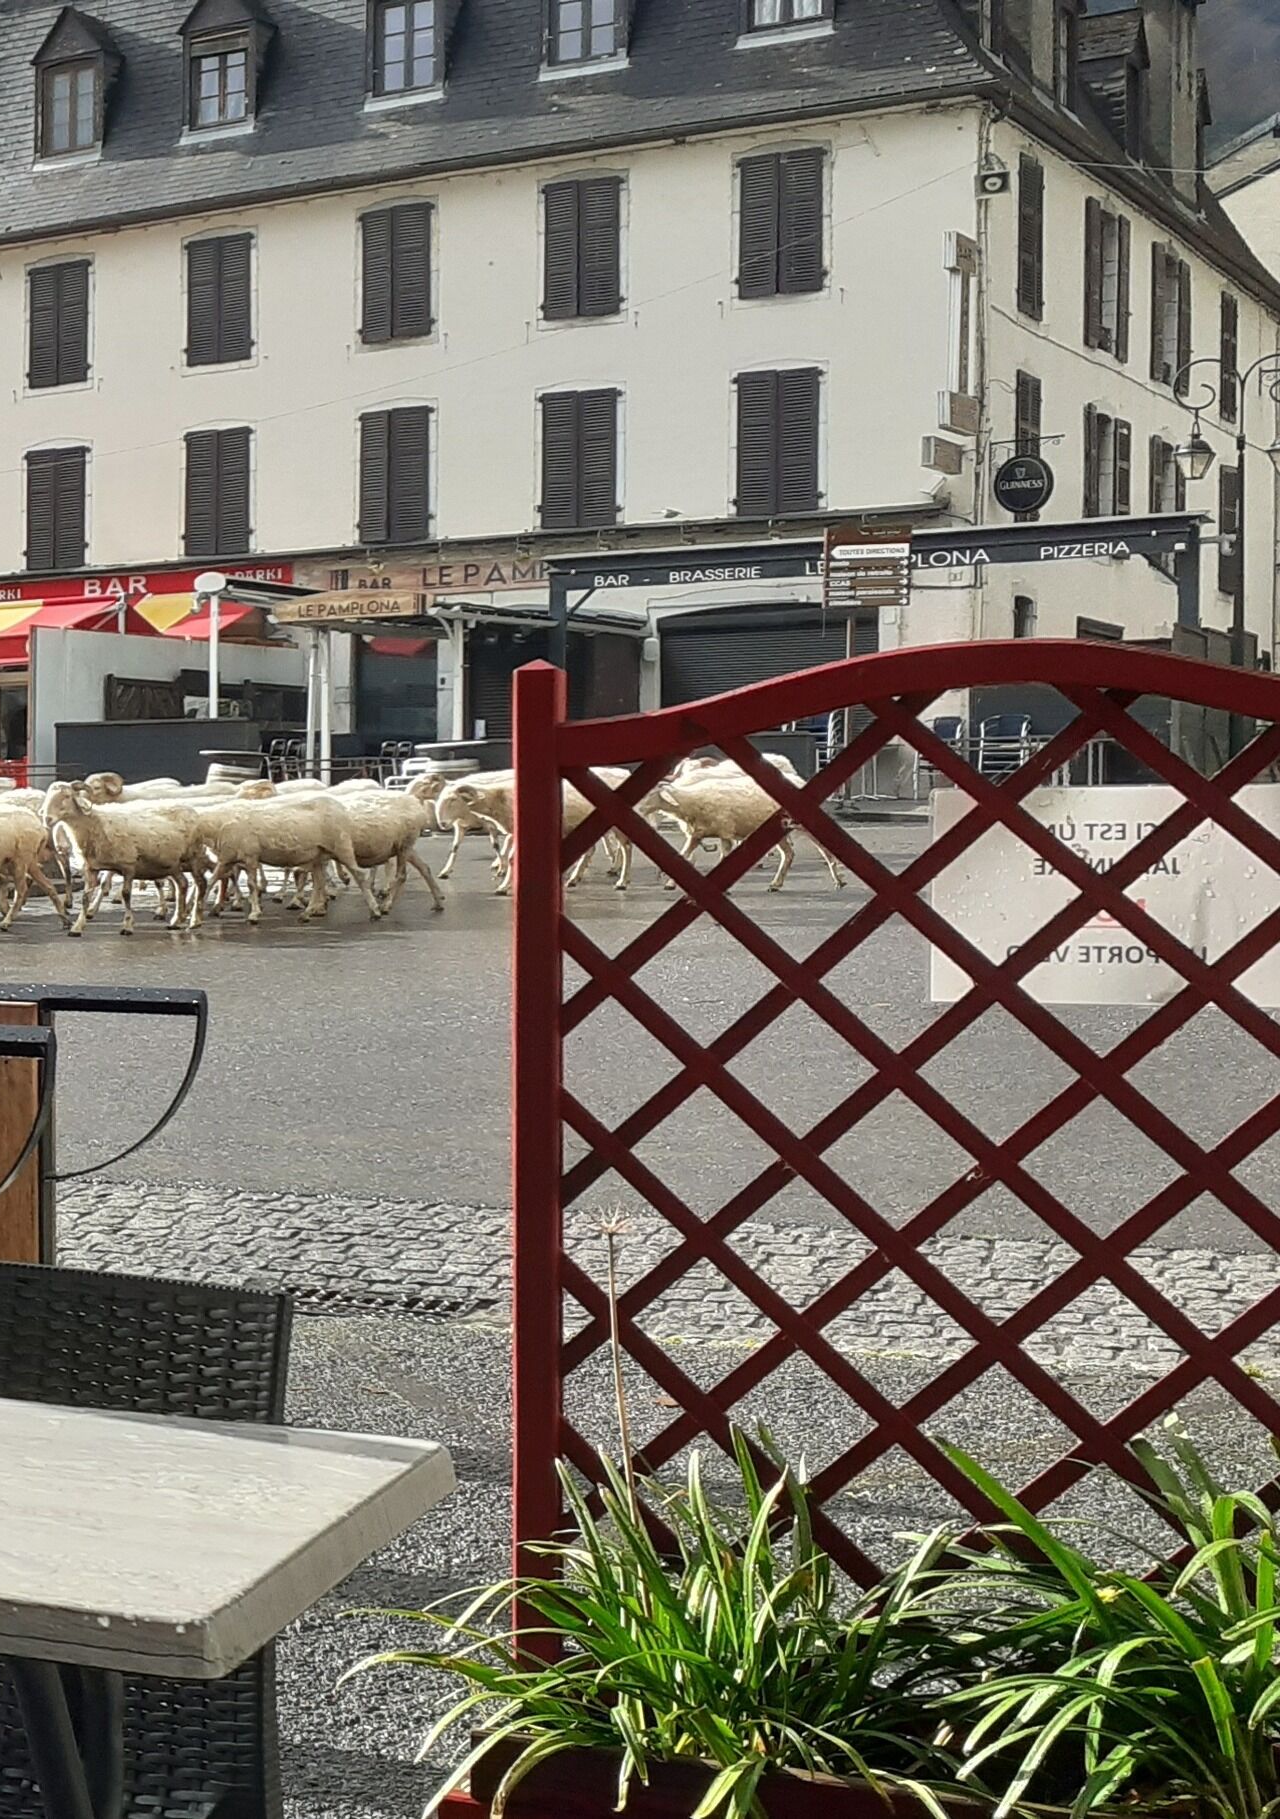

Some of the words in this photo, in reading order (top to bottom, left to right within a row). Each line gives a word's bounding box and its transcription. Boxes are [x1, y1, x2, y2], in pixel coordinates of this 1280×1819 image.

[999, 478, 1044, 491] GUINNESS
[866, 547, 905, 555] DIRECTIONS
[594, 574, 629, 587] BAR
[668, 566, 762, 583] BRASSERIE
[1040, 541, 1130, 560] PIZZERIA
[358, 577, 392, 589] BAR
[422, 565, 454, 587] LE
[83, 575, 147, 596] BAR
[298, 604, 314, 618] LE
[318, 600, 401, 617] PAMPLONA
